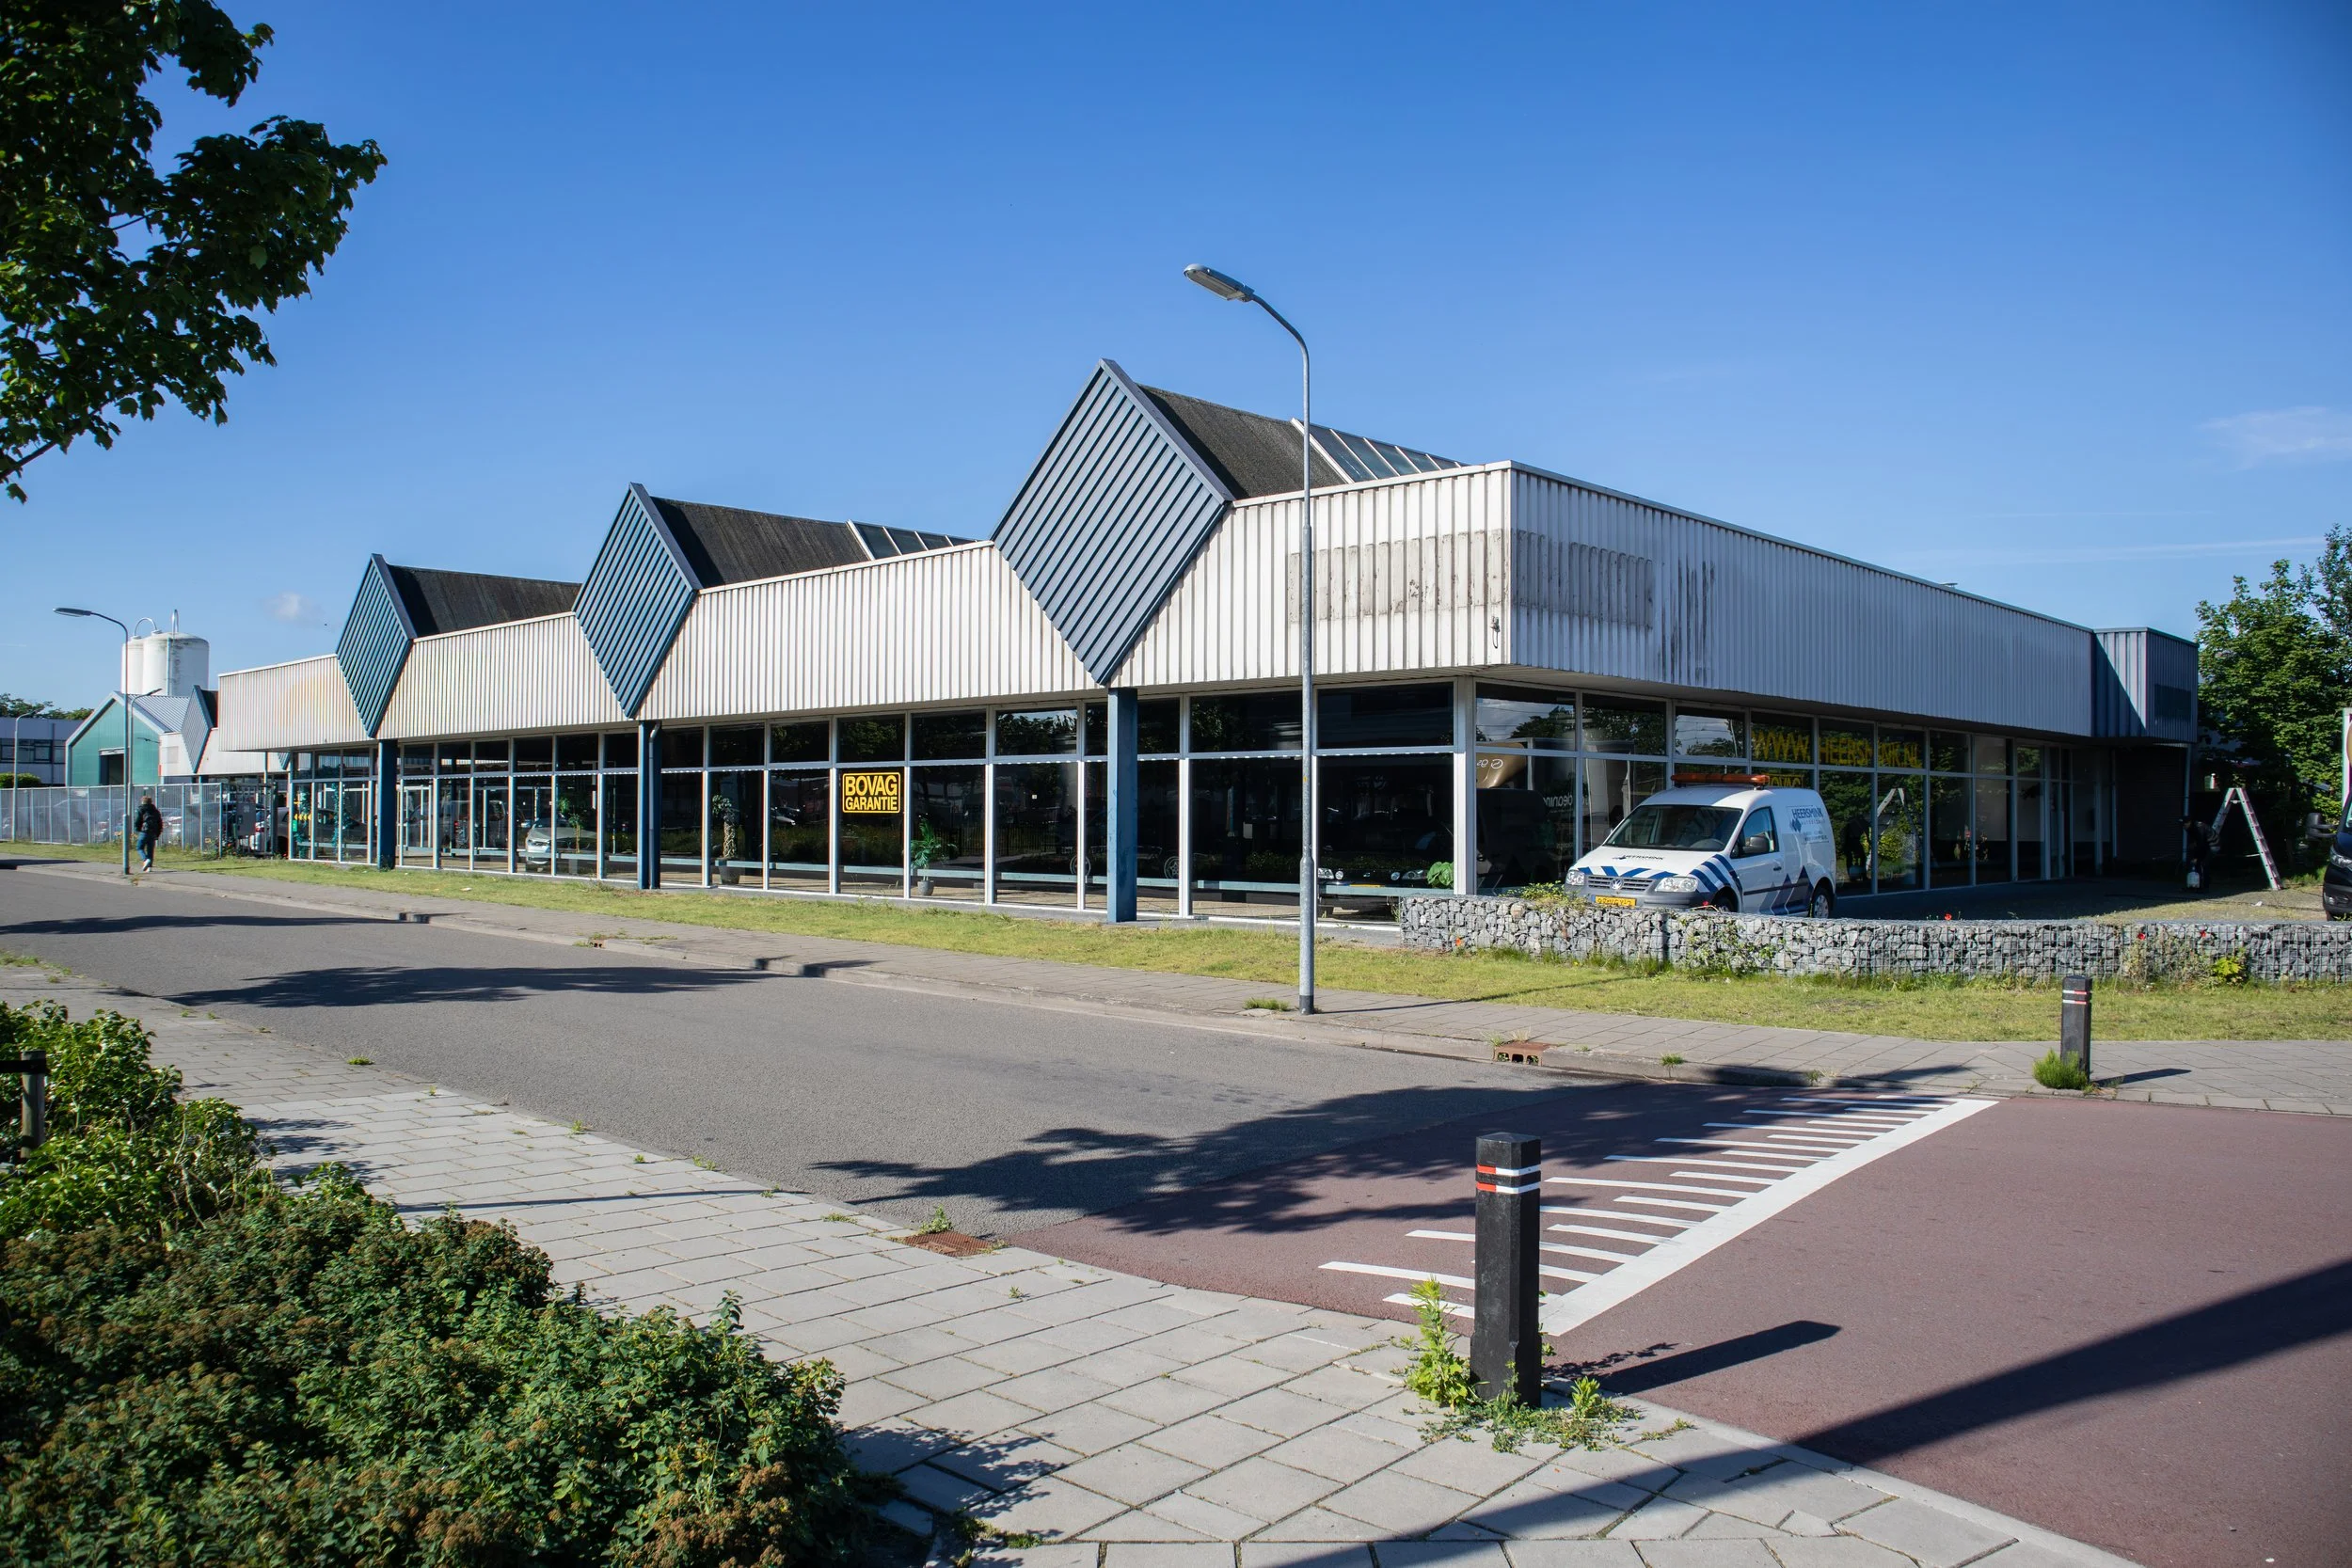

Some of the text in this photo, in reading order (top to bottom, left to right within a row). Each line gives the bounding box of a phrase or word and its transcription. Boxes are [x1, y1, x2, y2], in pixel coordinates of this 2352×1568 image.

[846, 775, 898, 796] BOVAG
[845, 797, 898, 811] GARANTIE
[1791, 807, 1823, 818] HEERSMINK
